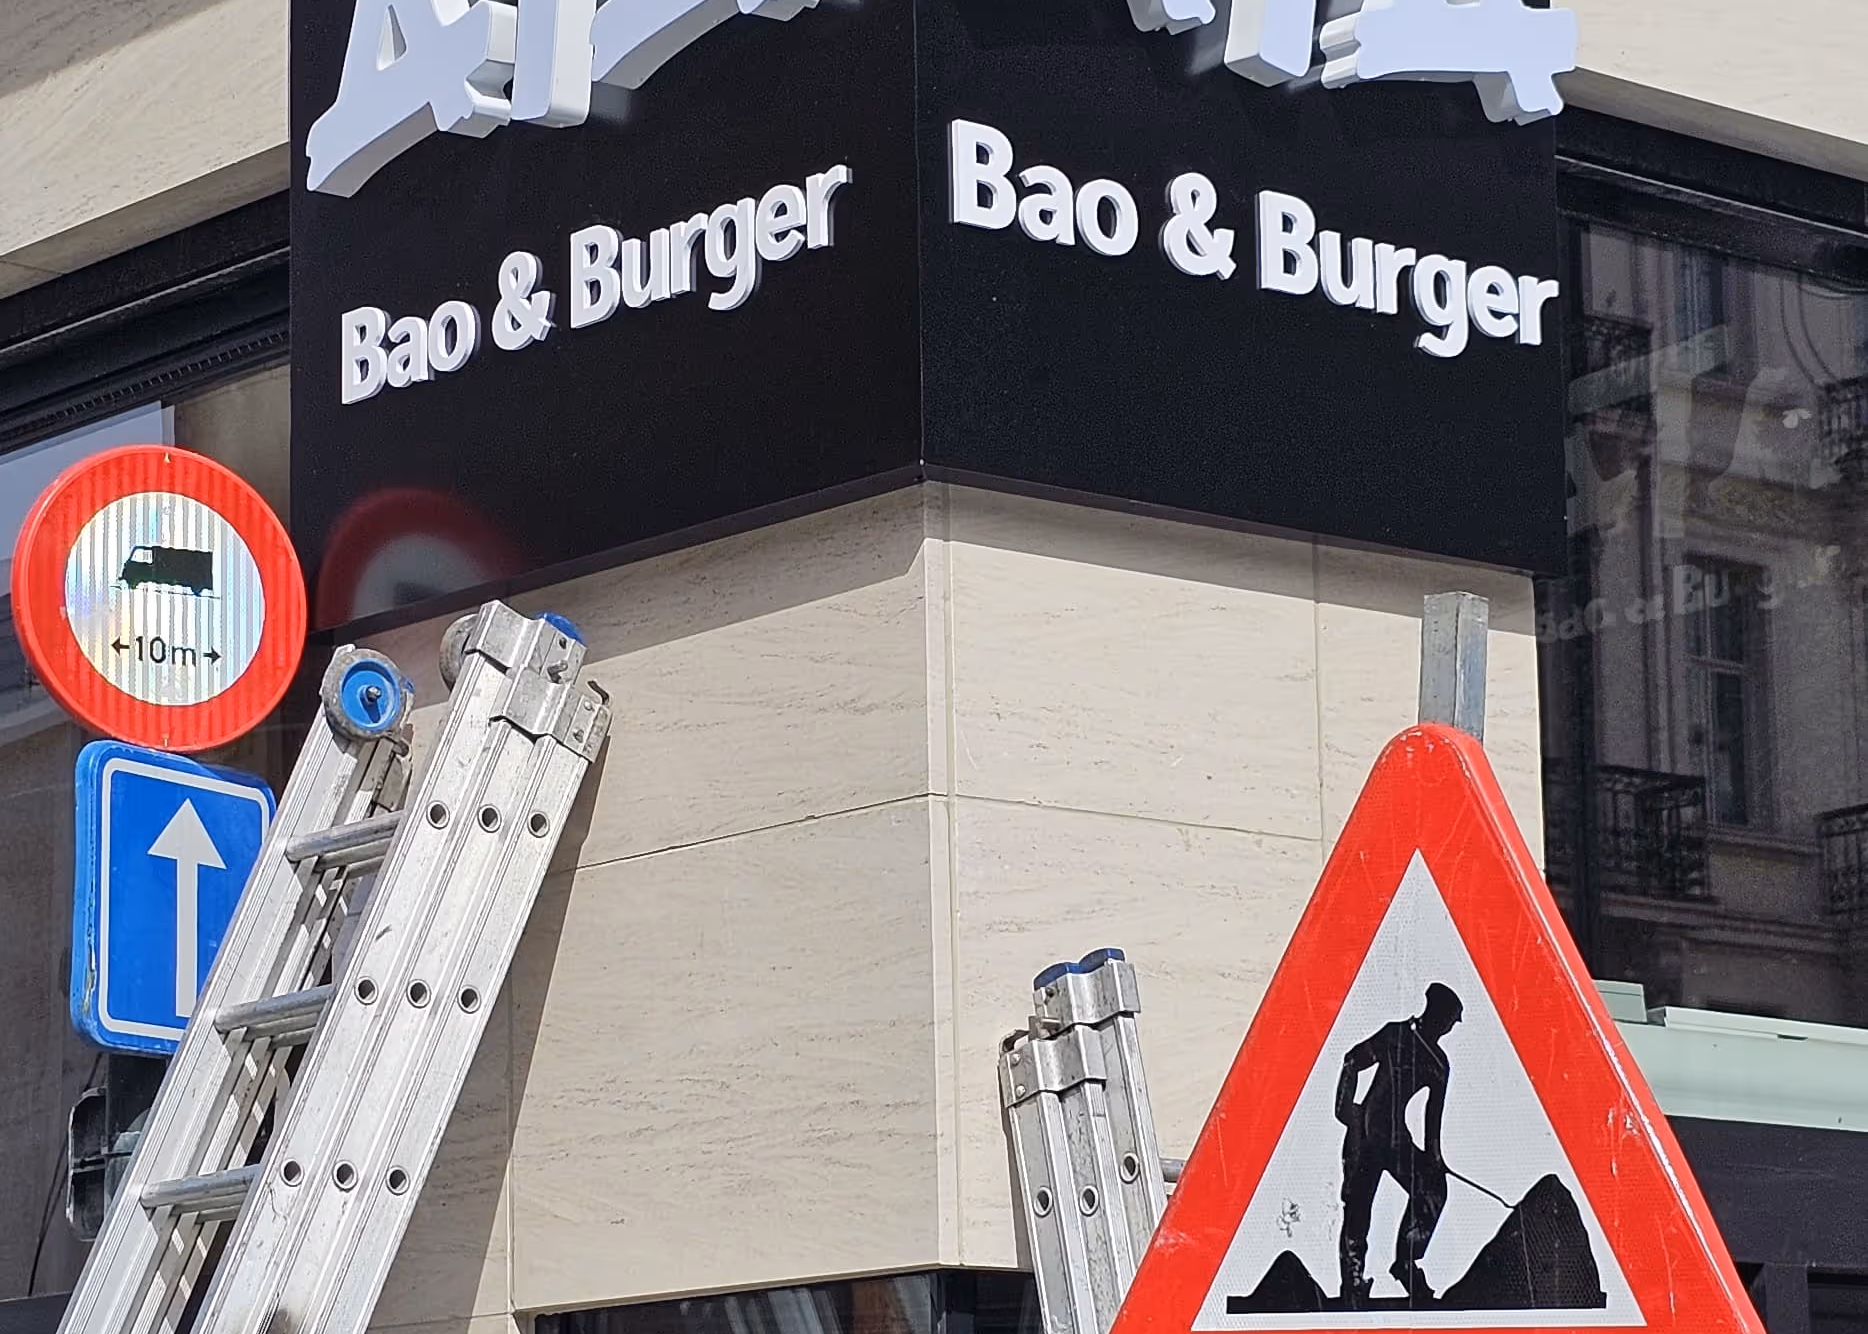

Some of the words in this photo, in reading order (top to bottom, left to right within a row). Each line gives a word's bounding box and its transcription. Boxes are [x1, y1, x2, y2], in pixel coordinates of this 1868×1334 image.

[341, 301, 478, 404] Bao
[491, 251, 555, 351] &
[570, 164, 853, 329] Burger
[950, 119, 1138, 257] Bao
[1161, 173, 1237, 282] &
[1257, 189, 1560, 358] Burger
